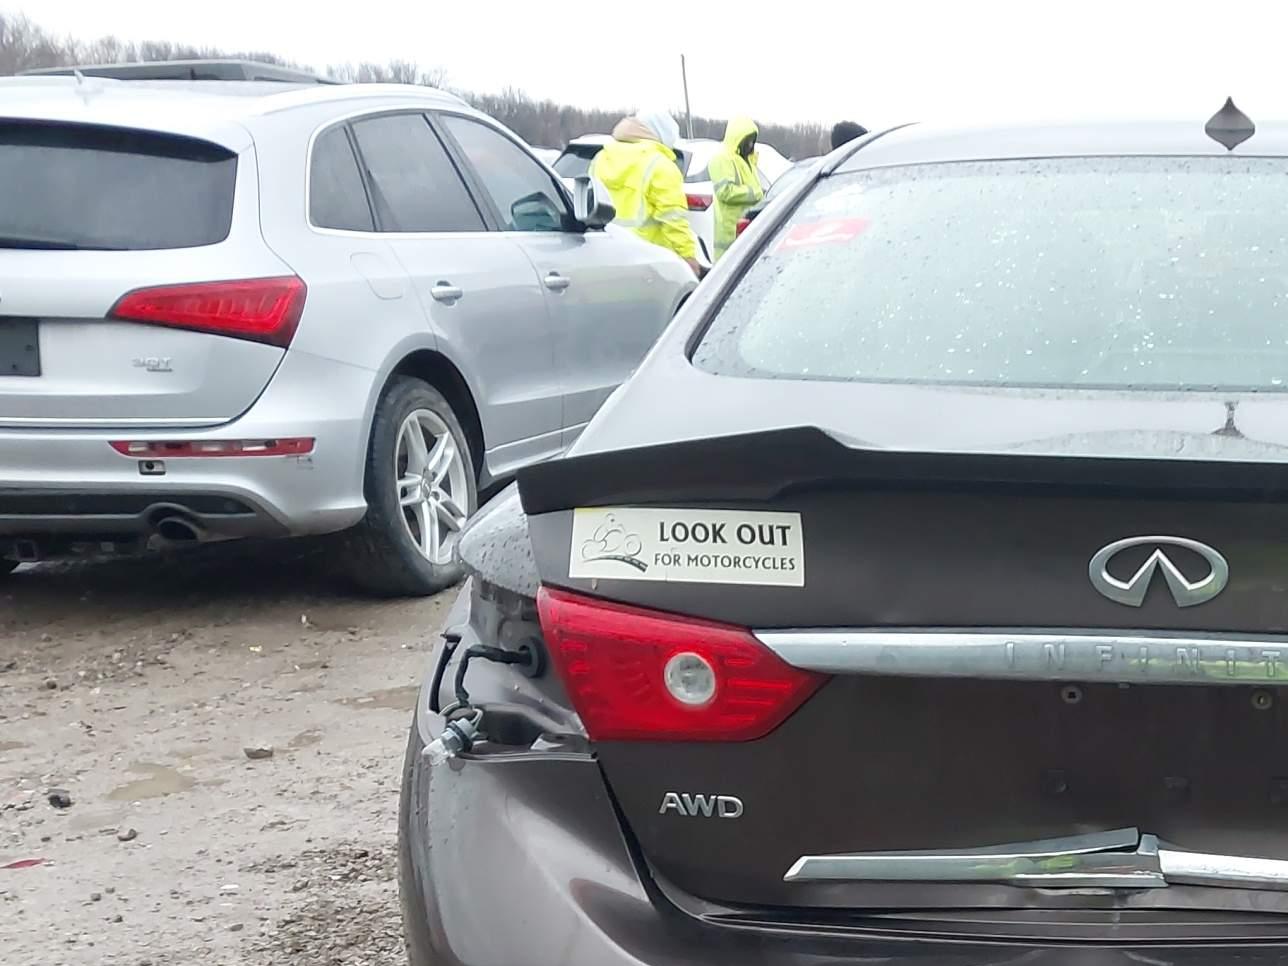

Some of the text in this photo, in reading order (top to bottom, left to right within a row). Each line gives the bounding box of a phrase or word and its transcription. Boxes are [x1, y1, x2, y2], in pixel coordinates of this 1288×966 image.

[658, 521, 792, 546] LOOK OUT
[654, 552, 796, 571] FOR MOTORCYCLES
[658, 792, 744, 818] AWD
